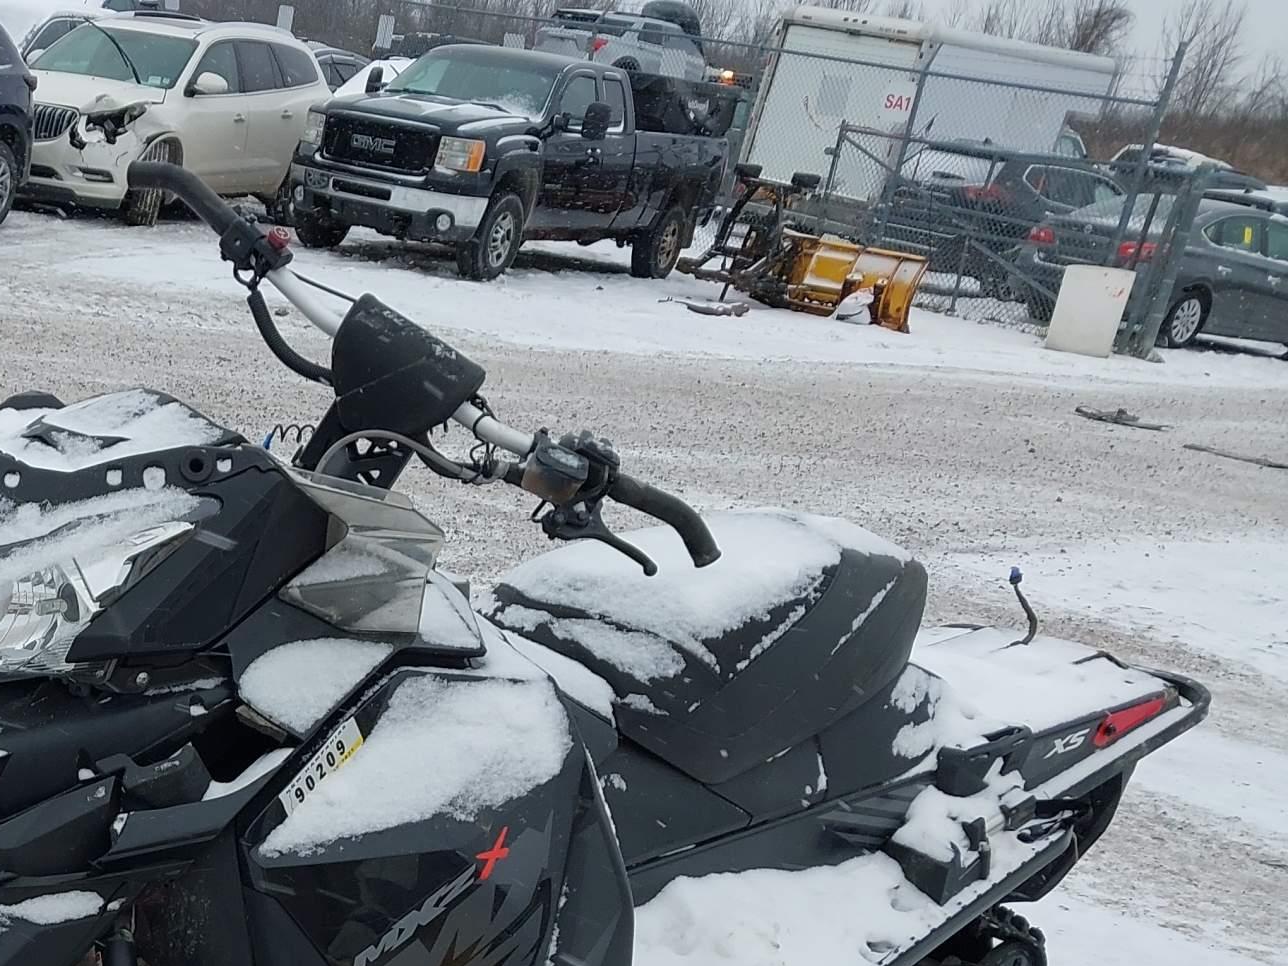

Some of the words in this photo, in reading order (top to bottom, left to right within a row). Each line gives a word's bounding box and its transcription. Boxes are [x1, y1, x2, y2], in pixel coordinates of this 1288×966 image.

[352, 133, 396, 154] GMC
[1043, 727, 1091, 760] XS
[294, 739, 346, 803] 90209
